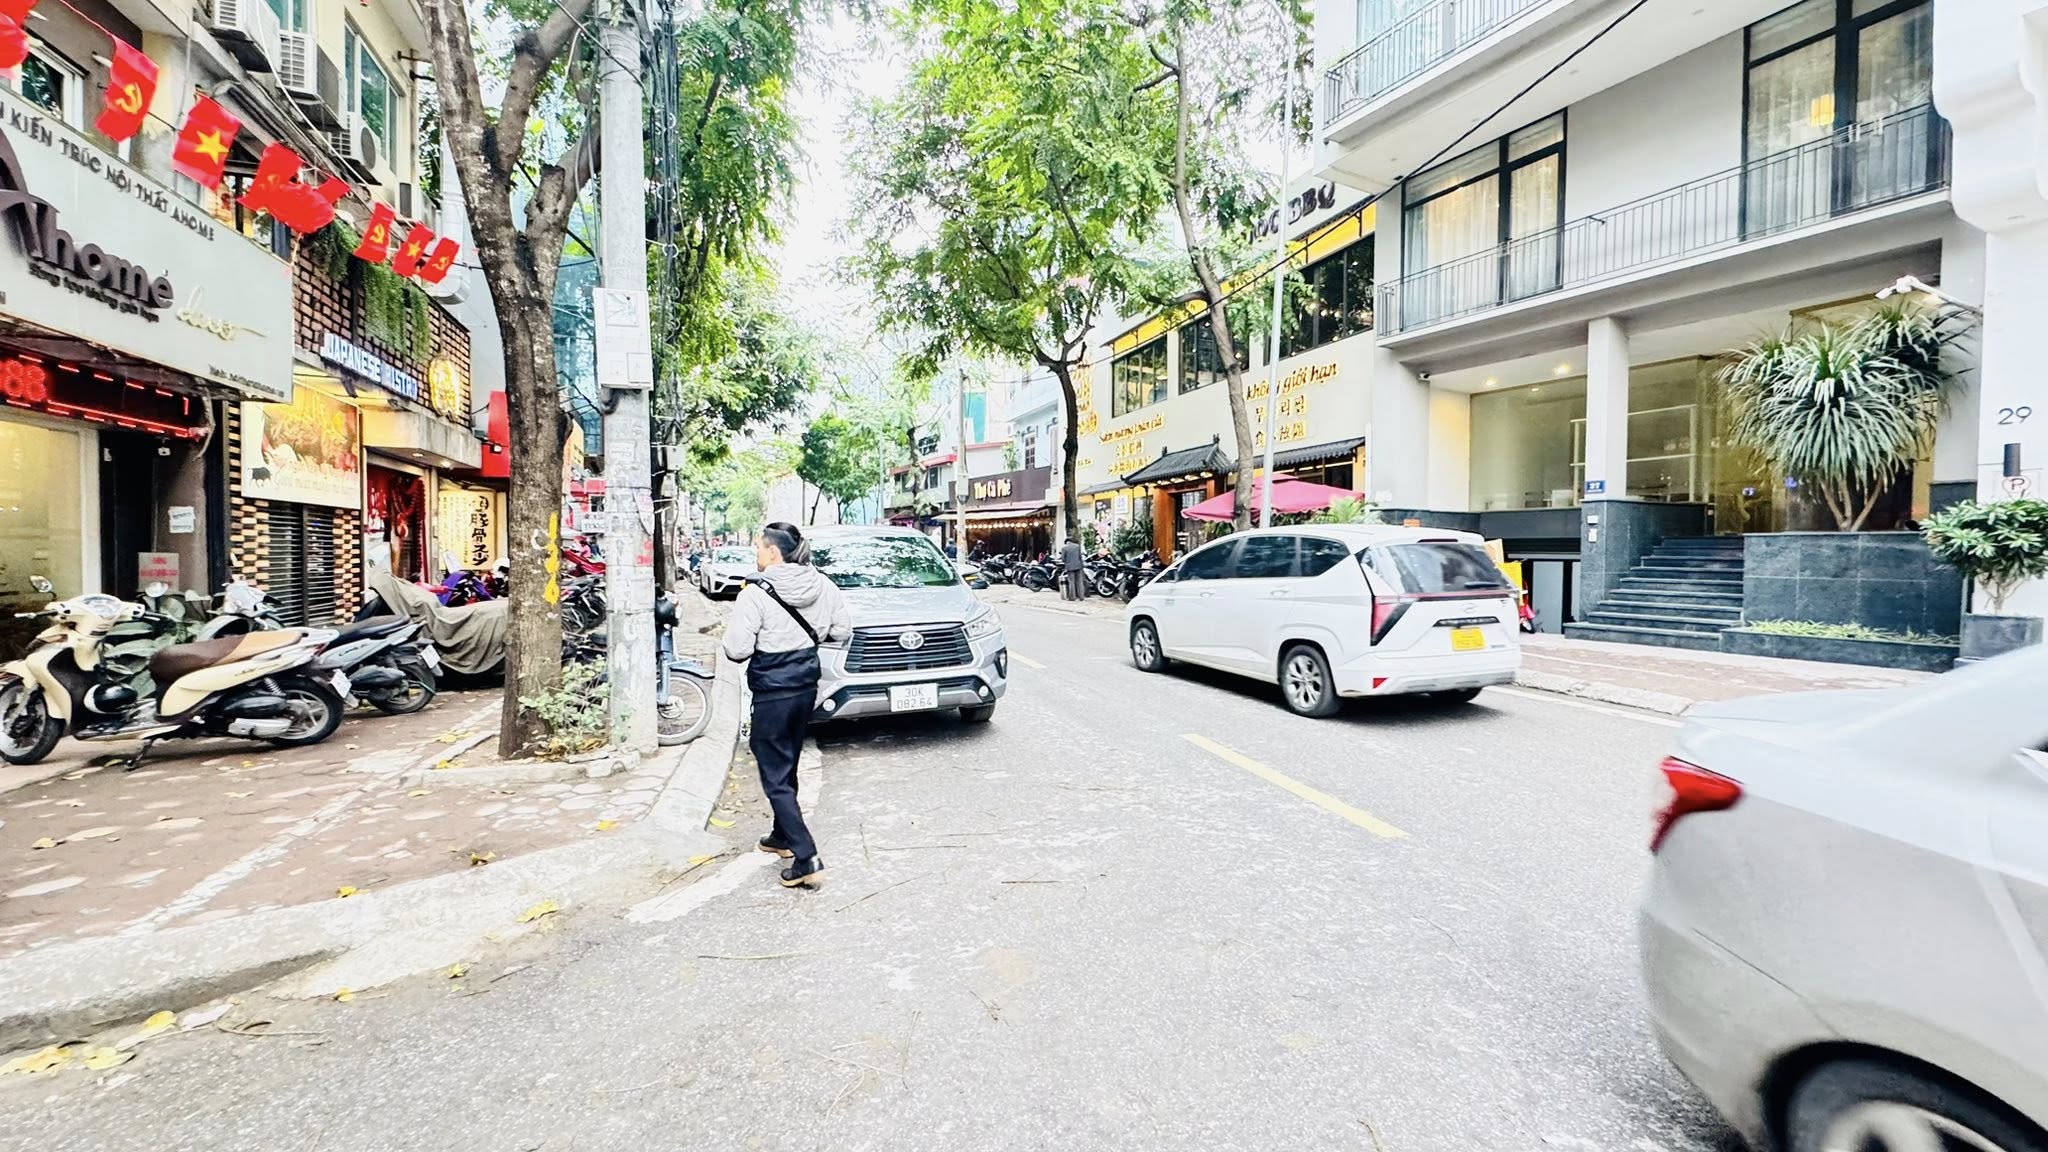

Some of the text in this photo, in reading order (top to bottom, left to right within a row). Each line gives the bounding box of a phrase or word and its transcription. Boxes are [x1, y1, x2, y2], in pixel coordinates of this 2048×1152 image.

[10, 107, 53, 148] KIẾN
[58, 137, 102, 174] TRÚC
[104, 163, 132, 194] NỘI
[135, 182, 169, 214] THẤT
[170, 208, 216, 242] AHOME
[1287, 181, 1336, 226] BBQ
[321, 332, 381, 383] JAPANESE
[1283, 367, 1308, 394] giới
[1310, 363, 1337, 384] hạn
[1998, 406, 2032, 424] 29
[905, 687, 924, 698] 30K
